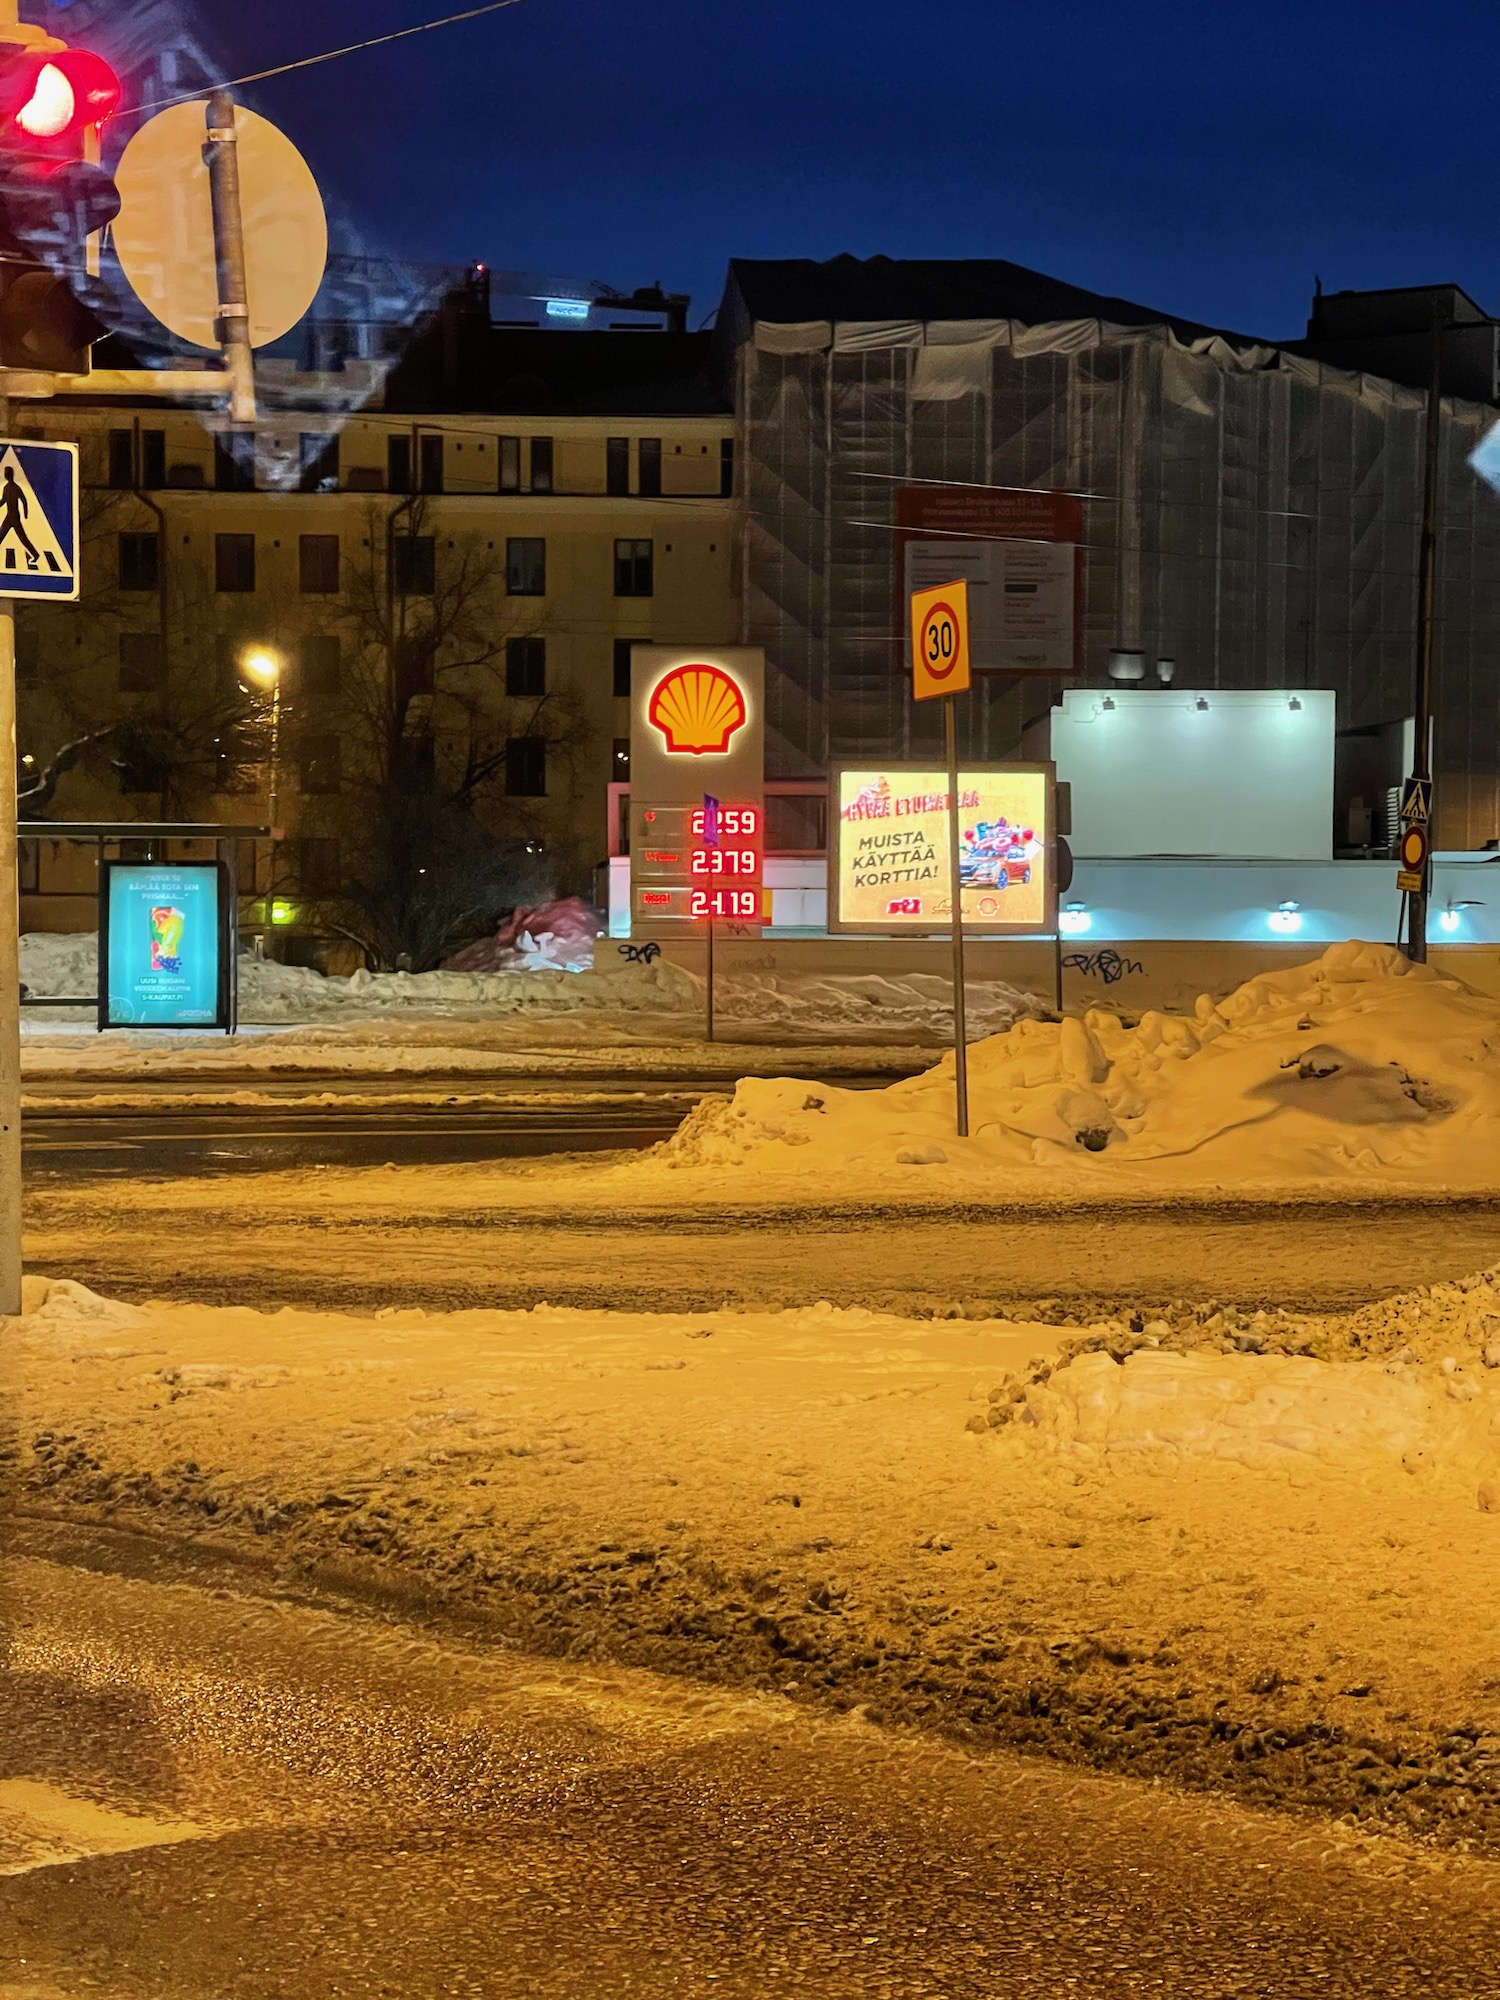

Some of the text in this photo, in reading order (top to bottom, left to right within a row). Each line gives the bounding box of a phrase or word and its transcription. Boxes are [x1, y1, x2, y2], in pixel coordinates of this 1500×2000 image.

[928, 621, 953, 661] 30
[859, 830, 925, 850] MUISTA
[692, 850, 755, 874] 2.379
[852, 844, 936, 870] KÄYTTÄÄ
[854, 865, 939, 888] KORTTIA!
